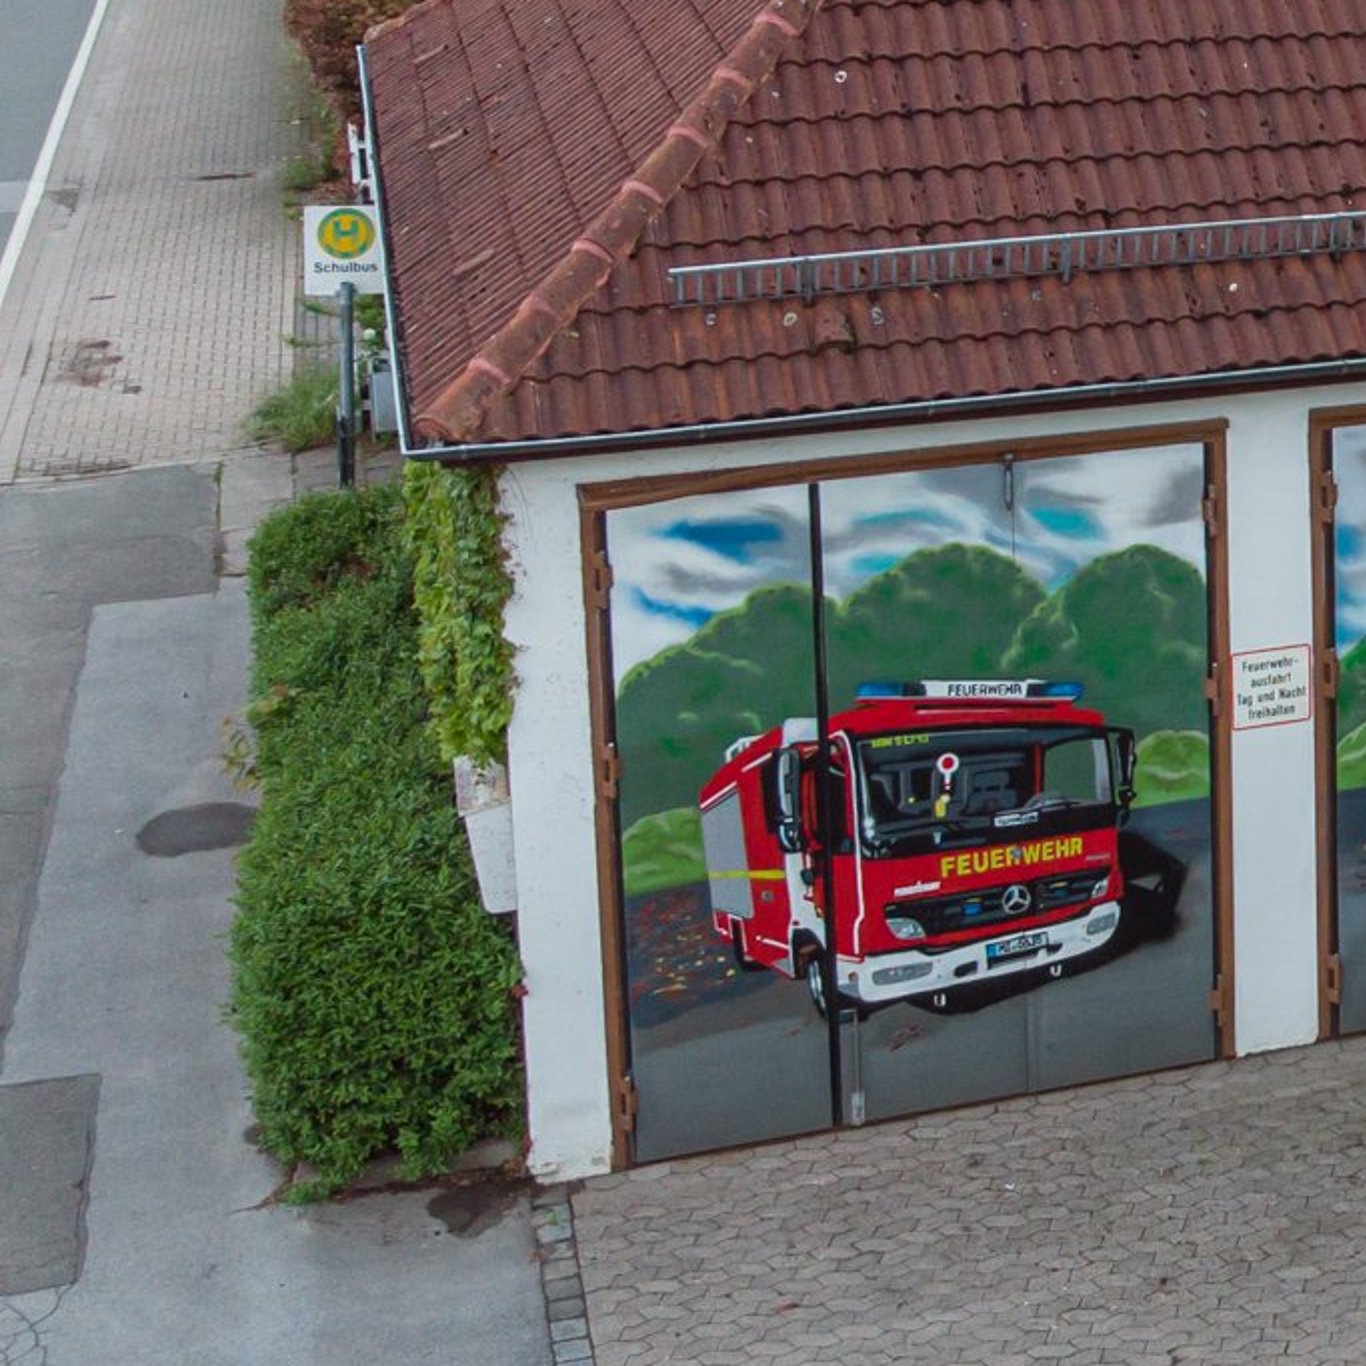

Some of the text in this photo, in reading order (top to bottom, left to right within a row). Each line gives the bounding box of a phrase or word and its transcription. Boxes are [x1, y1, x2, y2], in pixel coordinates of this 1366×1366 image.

[313, 261, 378, 273] Schulbus
[1250, 672, 1291, 687] ausfahrt
[948, 683, 1022, 697] FEUERWEHR
[1237, 686, 1306, 706] Tag und Nacht
[1248, 705, 1295, 719] freihalten
[941, 837, 1083, 878] FEUERWEHR
